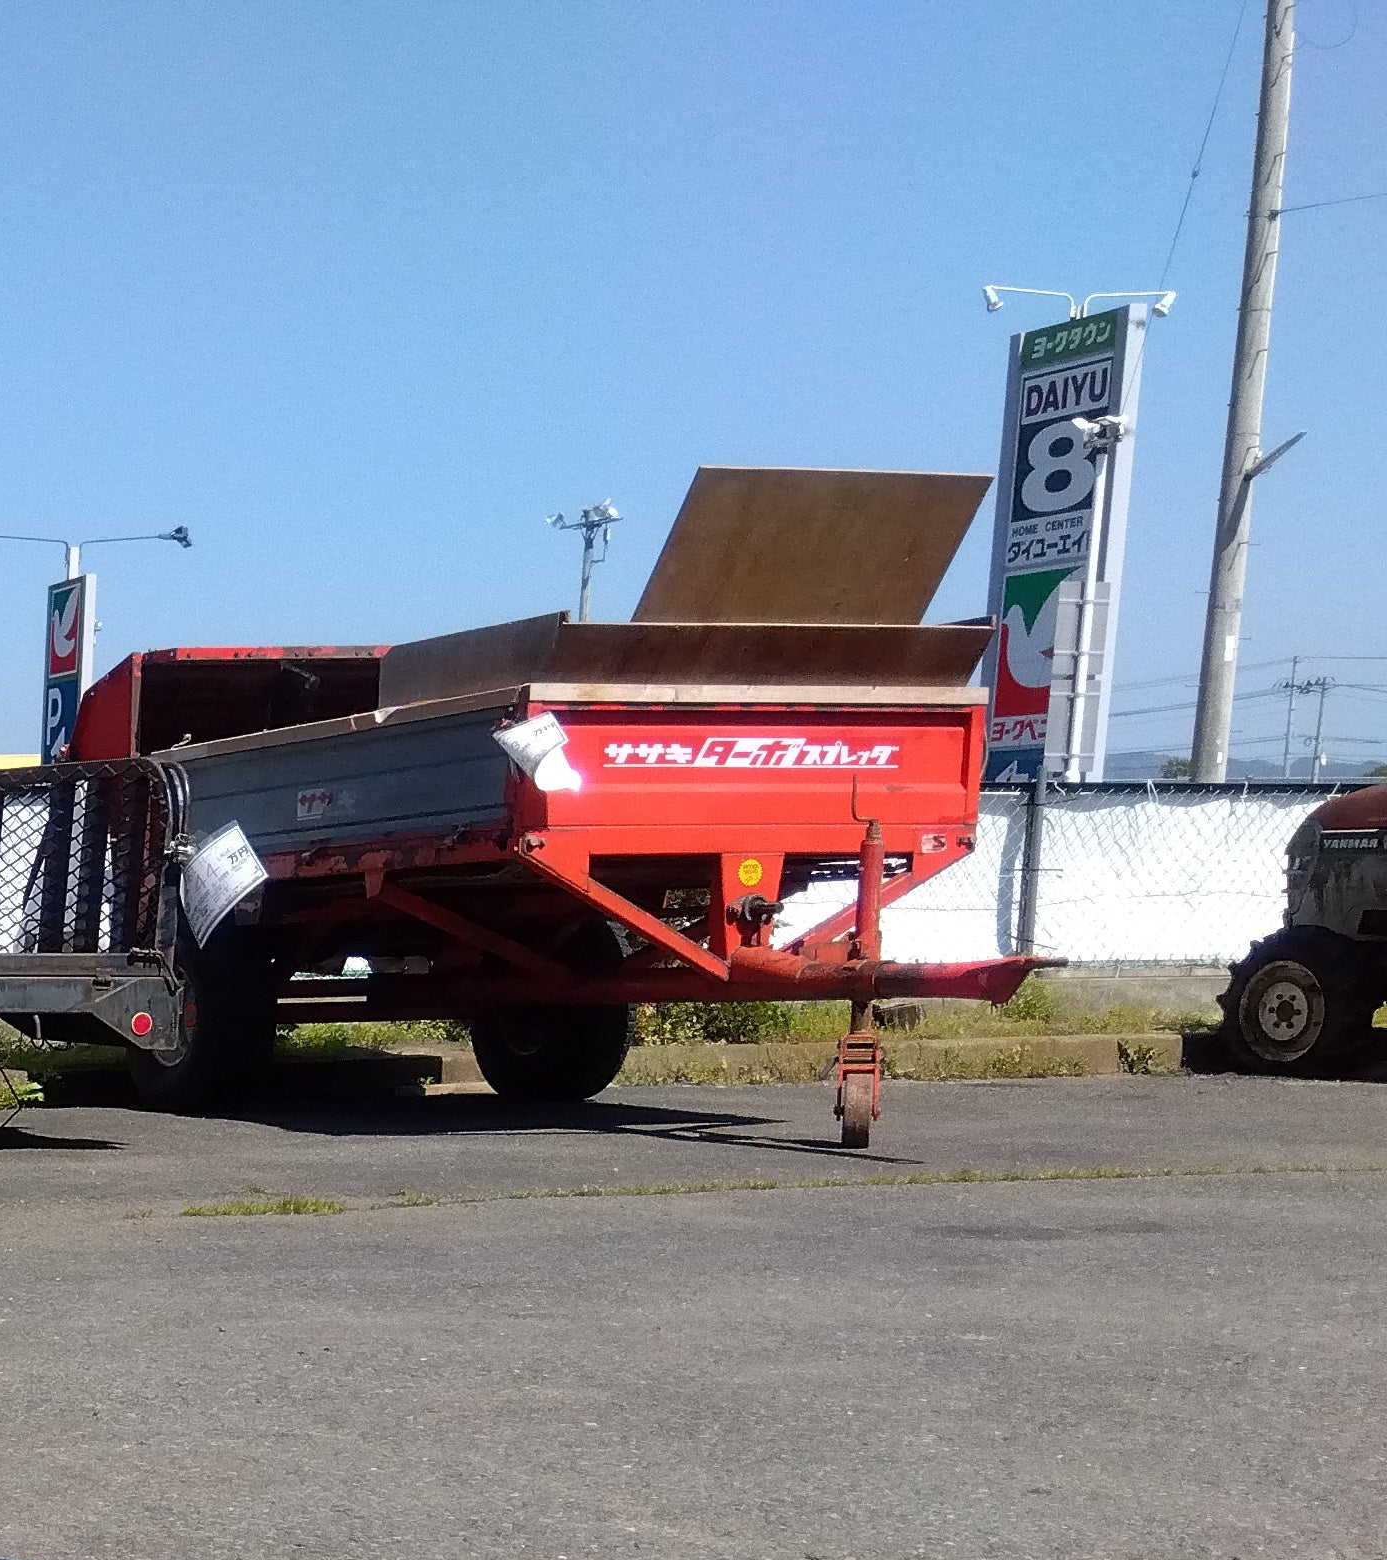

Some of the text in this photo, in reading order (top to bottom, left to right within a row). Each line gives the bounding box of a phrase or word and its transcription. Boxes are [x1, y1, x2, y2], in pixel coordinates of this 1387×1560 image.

[1031, 321, 1111, 360] ヨークタウン
[1025, 366, 1109, 418] DAIYU
[1021, 420, 1096, 513] 8
[1011, 515, 1084, 539] HOME CENTER
[47, 687, 62, 746] P
